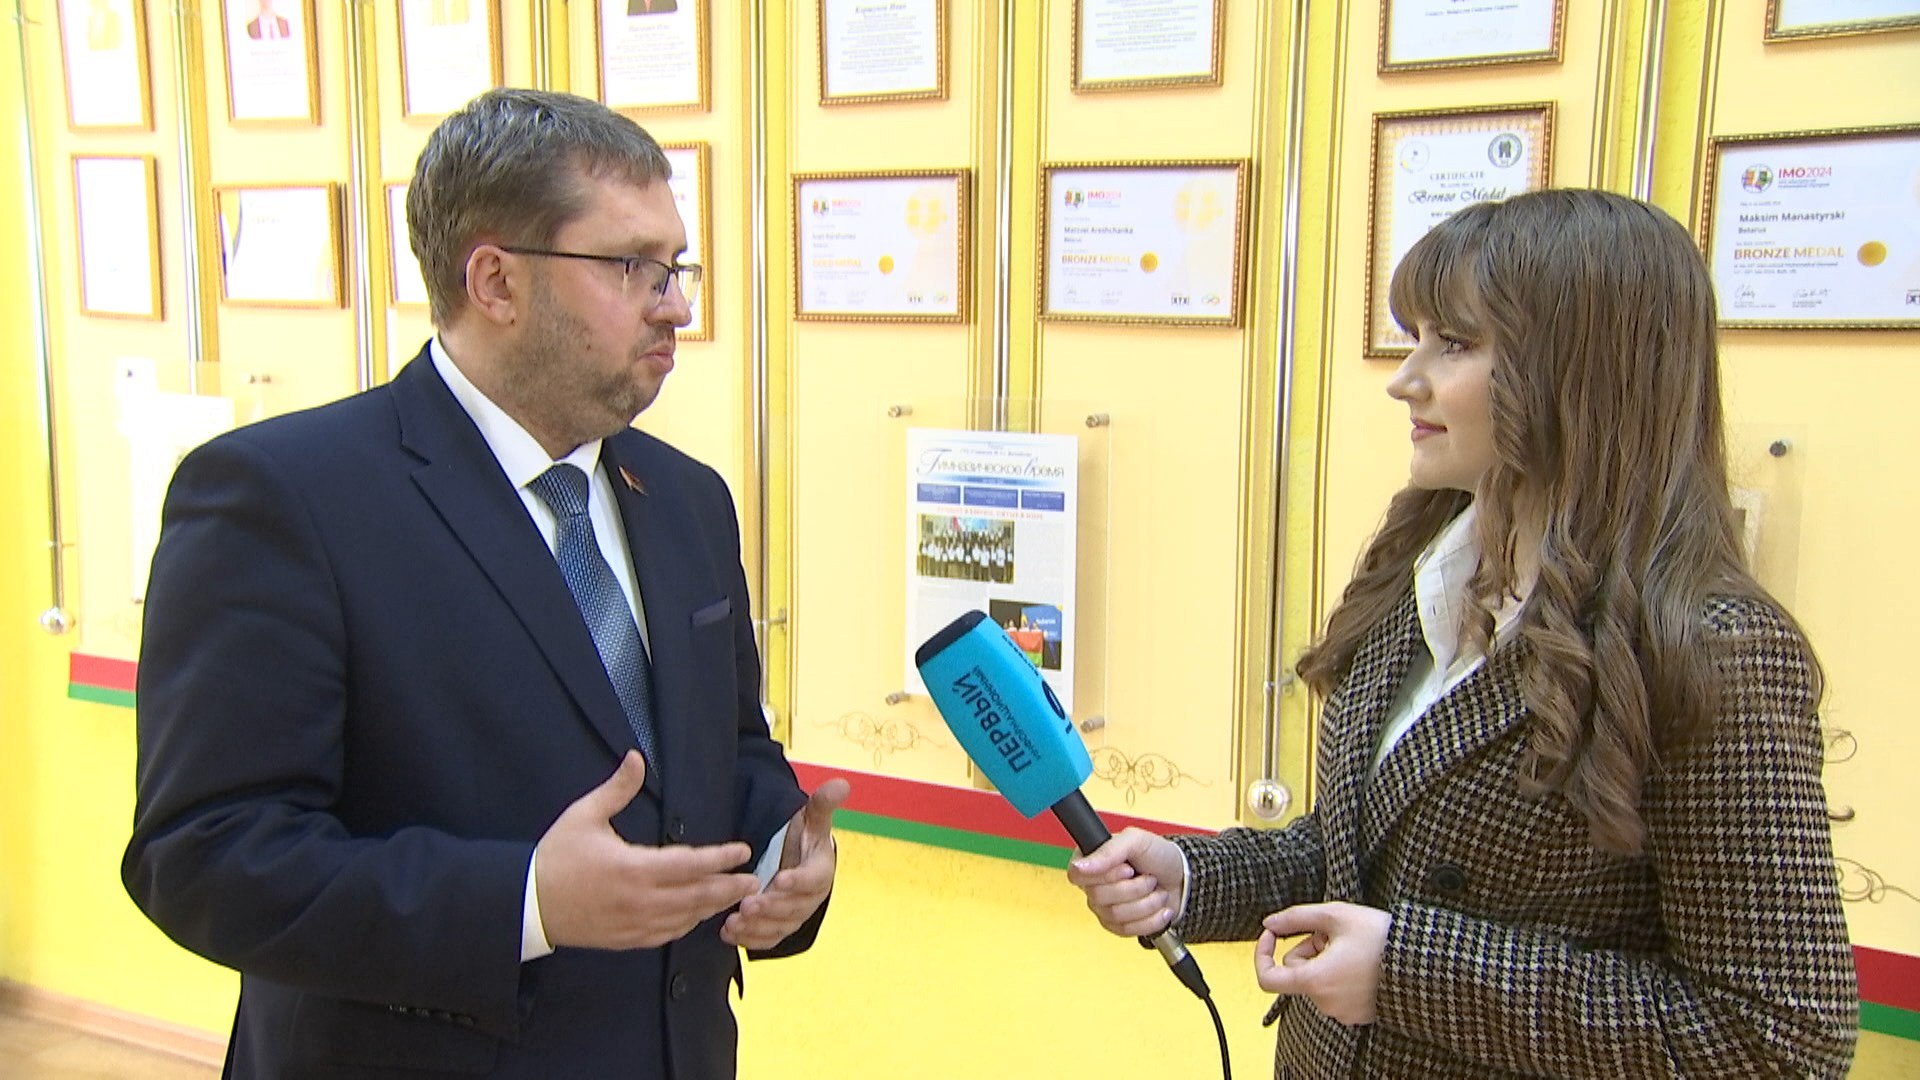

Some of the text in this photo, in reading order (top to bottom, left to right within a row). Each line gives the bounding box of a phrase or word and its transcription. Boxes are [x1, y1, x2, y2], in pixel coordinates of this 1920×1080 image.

[1430, 171, 1484, 181] CERTIFICATE
[1778, 166, 1832, 178] IMO2024
[1408, 187, 1507, 204] Bronze Medal
[1739, 210, 1844, 223] Maksim Manastyrski
[1734, 246, 1845, 260] BRONZE MEDAL
[1062, 255, 1098, 265] BRONZE
[952, 673, 1032, 773] ПЕРВЫЙ
